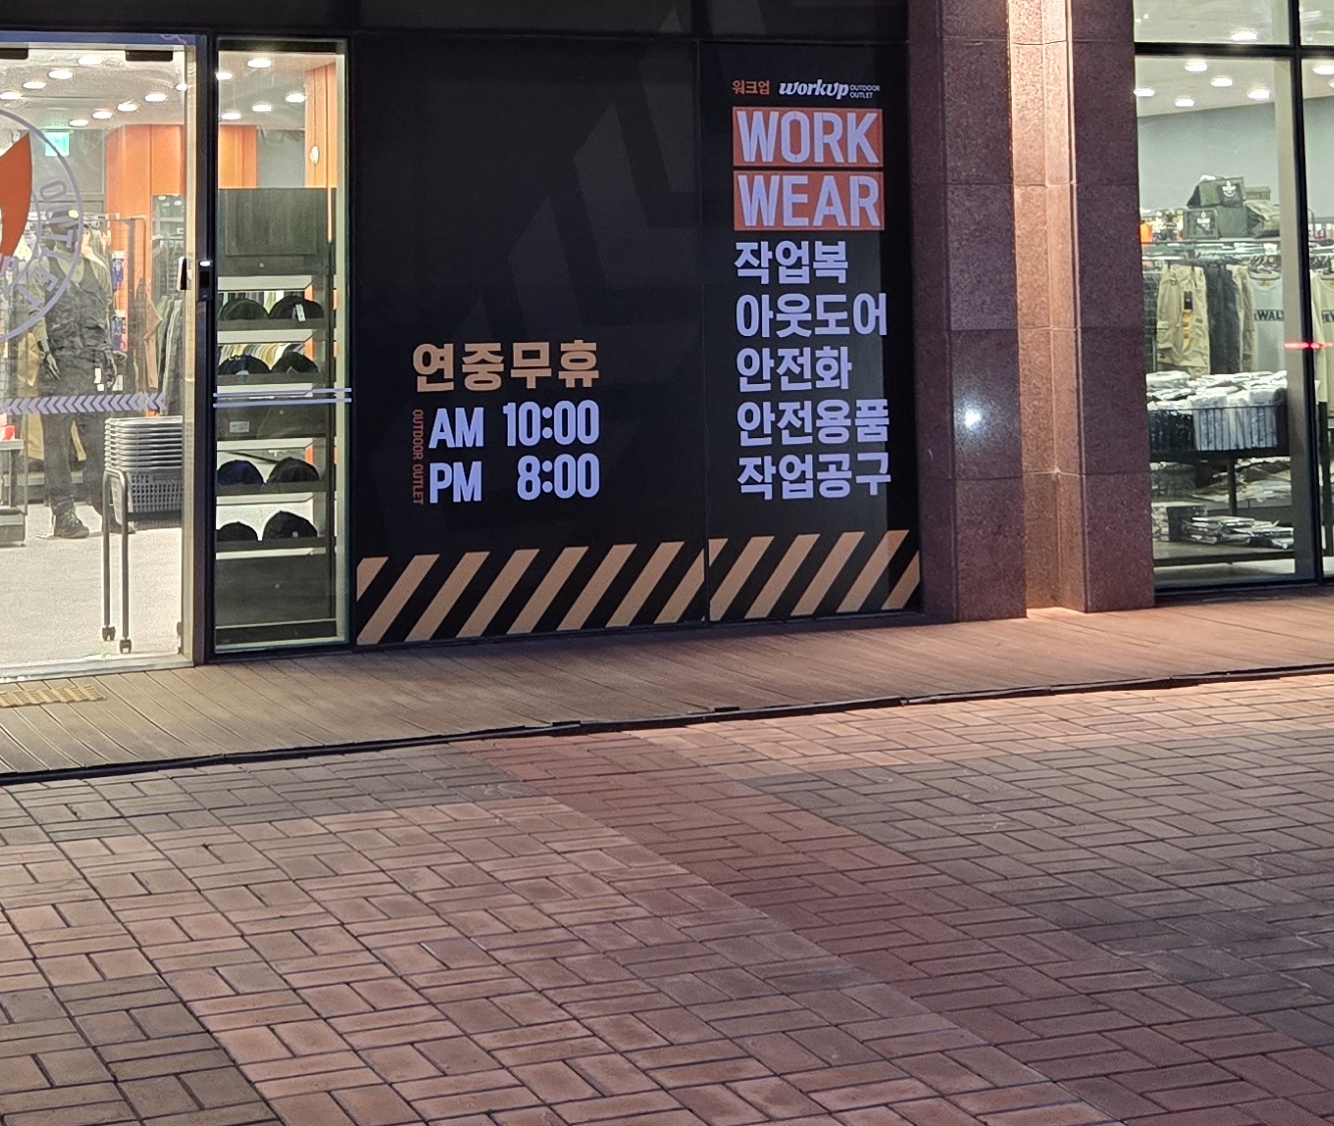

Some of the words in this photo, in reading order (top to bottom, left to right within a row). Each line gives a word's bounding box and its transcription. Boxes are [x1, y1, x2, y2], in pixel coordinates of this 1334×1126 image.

[732, 80, 770, 95] 워크업
[778, 79, 849, 100] workup
[849, 84, 880, 92] OUTDOOR
[849, 91, 873, 99] OUTLET
[736, 111, 879, 163] WORK
[737, 175, 881, 227] WEAR
[734, 240, 849, 284] 작업복
[735, 292, 888, 338] 아웃도어
[412, 340, 599, 392] 연중무휴
[736, 346, 852, 393] 안전화
[412, 409, 424, 461] OUTDOOR
[428, 406, 484, 448] AM
[502, 400, 600, 447] 10:00
[736, 398, 890, 447] 안전용품
[412, 464, 424, 505] OUTLET
[429, 461, 483, 504] PM
[517, 453, 600, 501] 8:00
[737, 452, 891, 500] 작업공구
